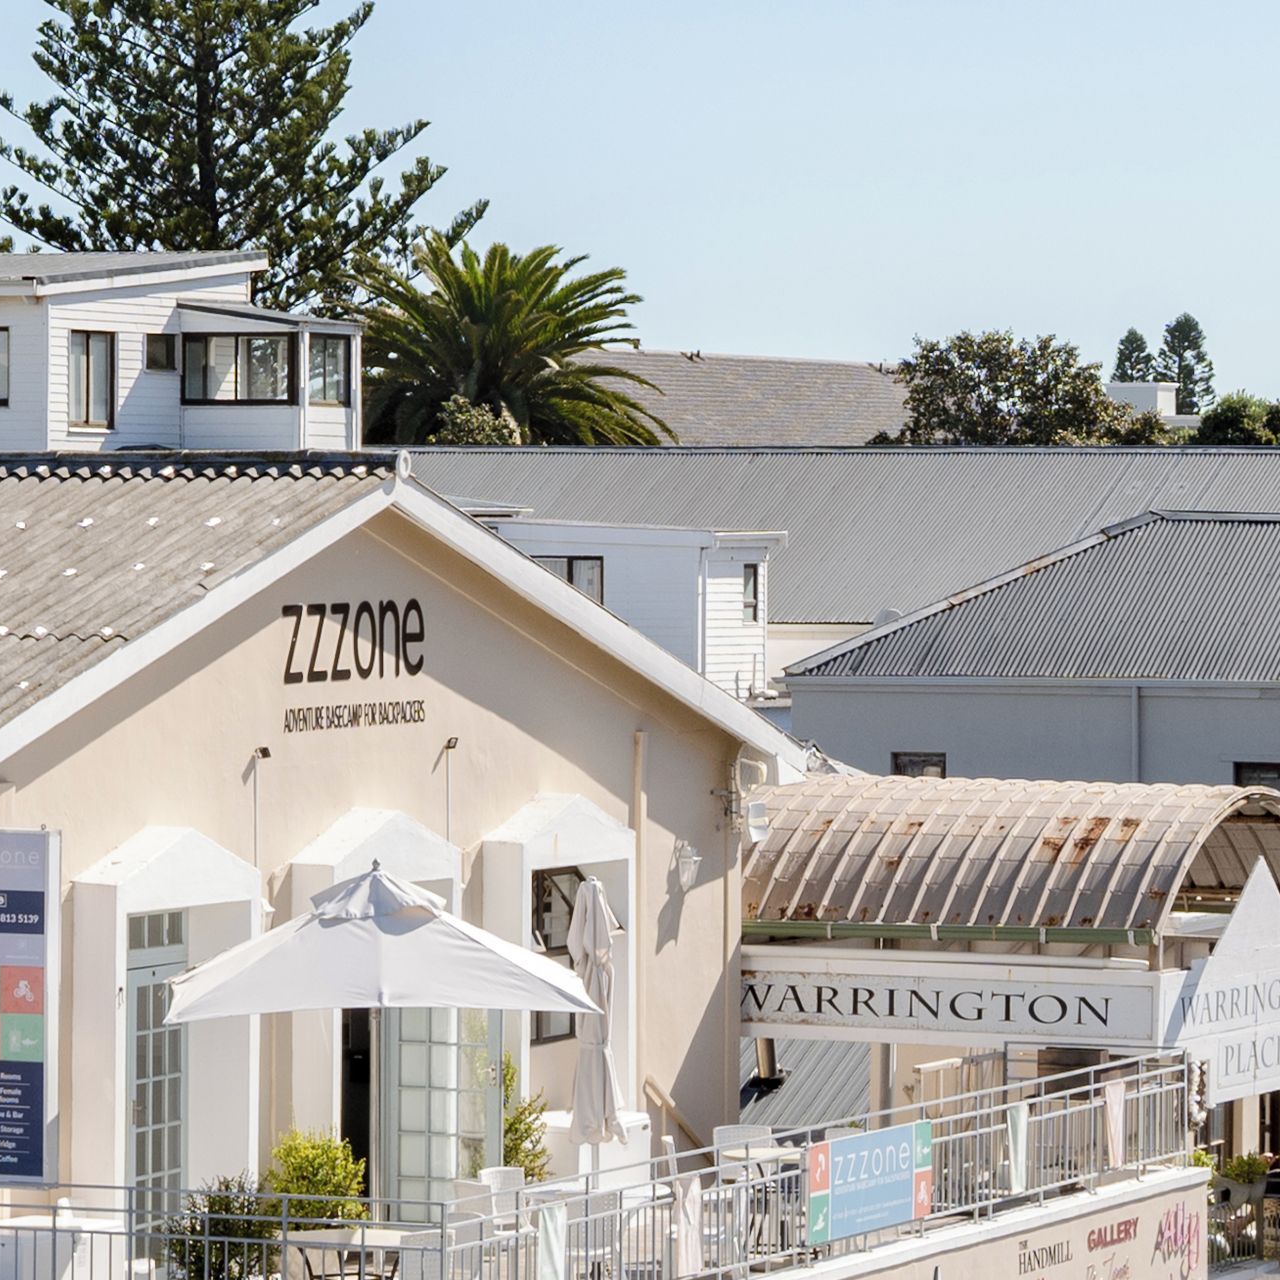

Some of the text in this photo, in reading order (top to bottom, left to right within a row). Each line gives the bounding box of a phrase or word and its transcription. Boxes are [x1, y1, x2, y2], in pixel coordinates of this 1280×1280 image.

[282, 598, 425, 685] zzzone
[283, 700, 425, 734] ADVENTURE BASECAMP FOR BACKPACKERS
[834, 1142, 911, 1185] zzzone
[1087, 1217, 1139, 1252] GALLERY
[1018, 1240, 1073, 1275] HANDMILL
